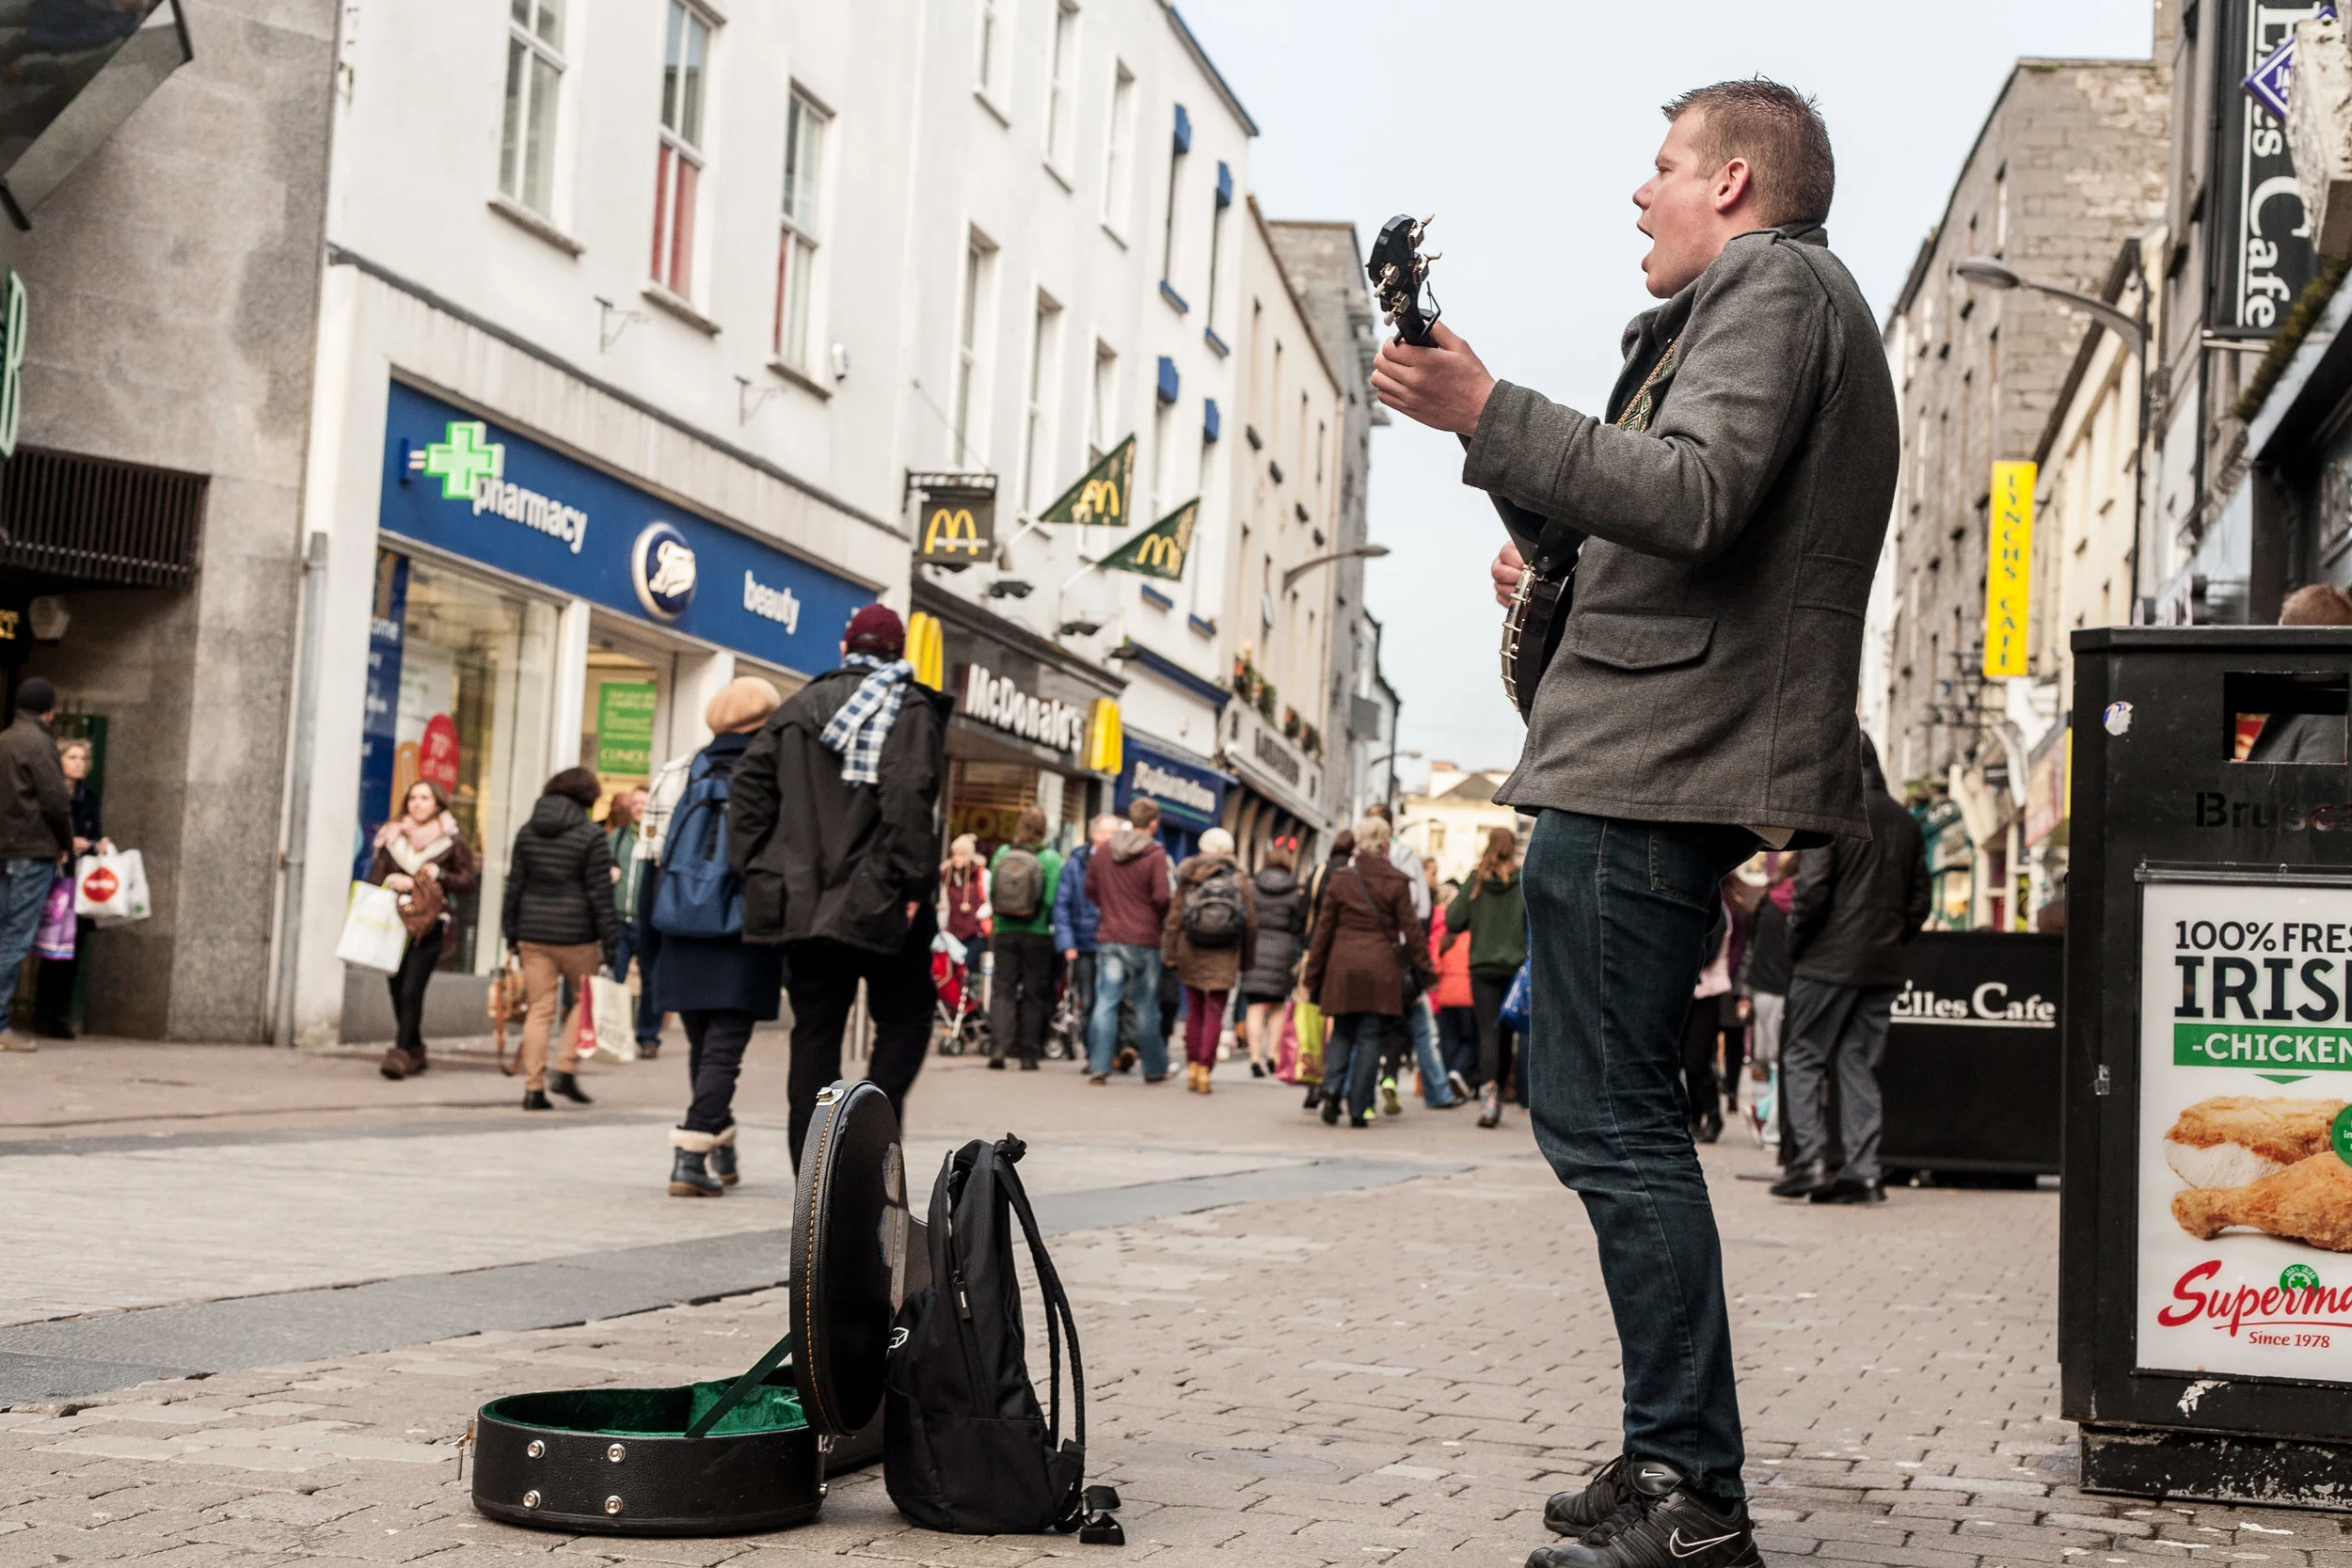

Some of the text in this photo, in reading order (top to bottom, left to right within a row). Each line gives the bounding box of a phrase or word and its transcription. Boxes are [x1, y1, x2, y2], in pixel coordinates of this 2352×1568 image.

[2245, 175, 2312, 328] Cafe
[472, 476, 588, 554] pharmacy
[743, 569, 800, 636] beauty
[965, 663, 1082, 752] McDonald's
[2175, 920, 2277, 951] 100%
[1972, 981, 2057, 1022] Cafe
[2249, 1331, 2330, 1349] Since 1978
